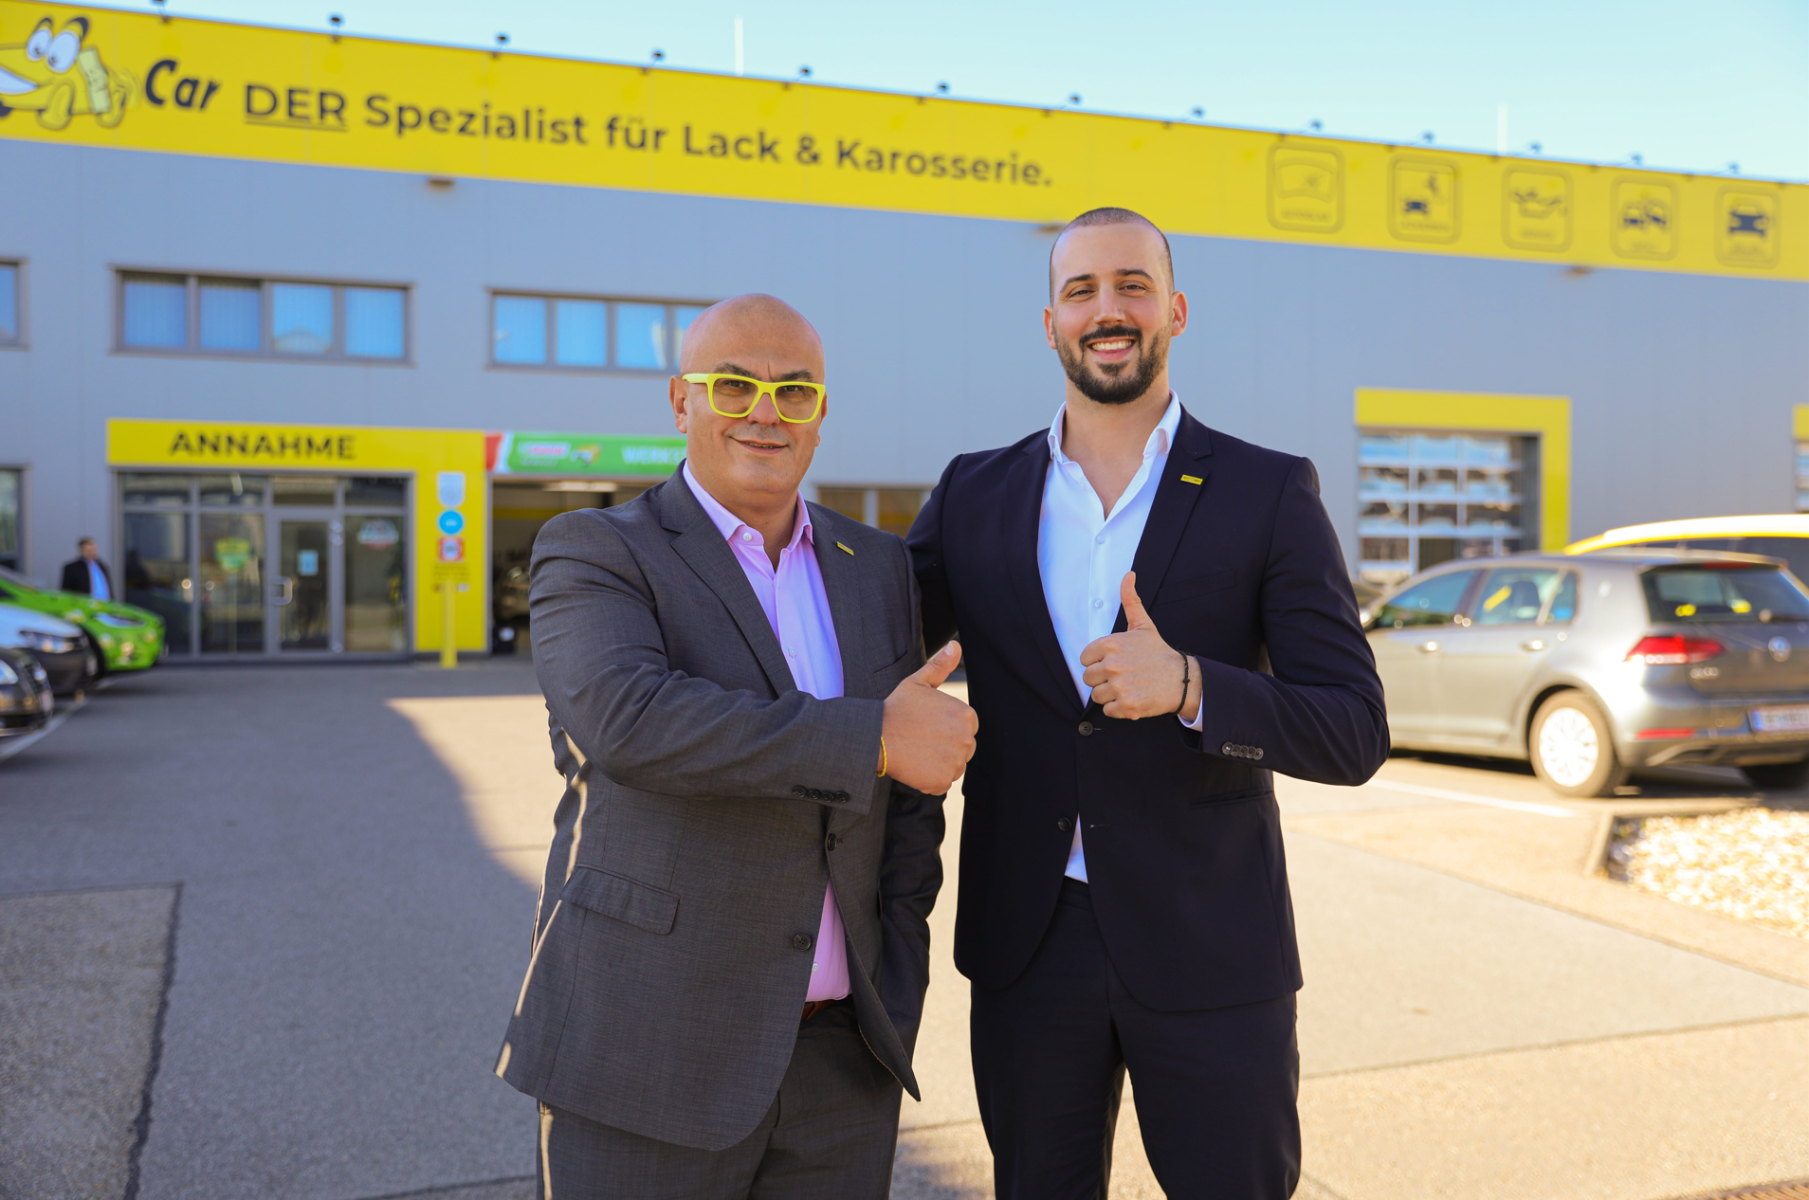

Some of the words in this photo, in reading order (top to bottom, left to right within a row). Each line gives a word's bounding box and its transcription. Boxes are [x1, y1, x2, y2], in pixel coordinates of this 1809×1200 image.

[144, 58, 221, 111] Car
[244, 83, 347, 121] DER
[364, 94, 588, 145] Spezialist
[606, 116, 667, 150] für
[684, 125, 780, 163] Lack
[795, 134, 821, 165] &
[836, 140, 1052, 186] Karosserie.
[169, 432, 355, 459] ANNAHME
